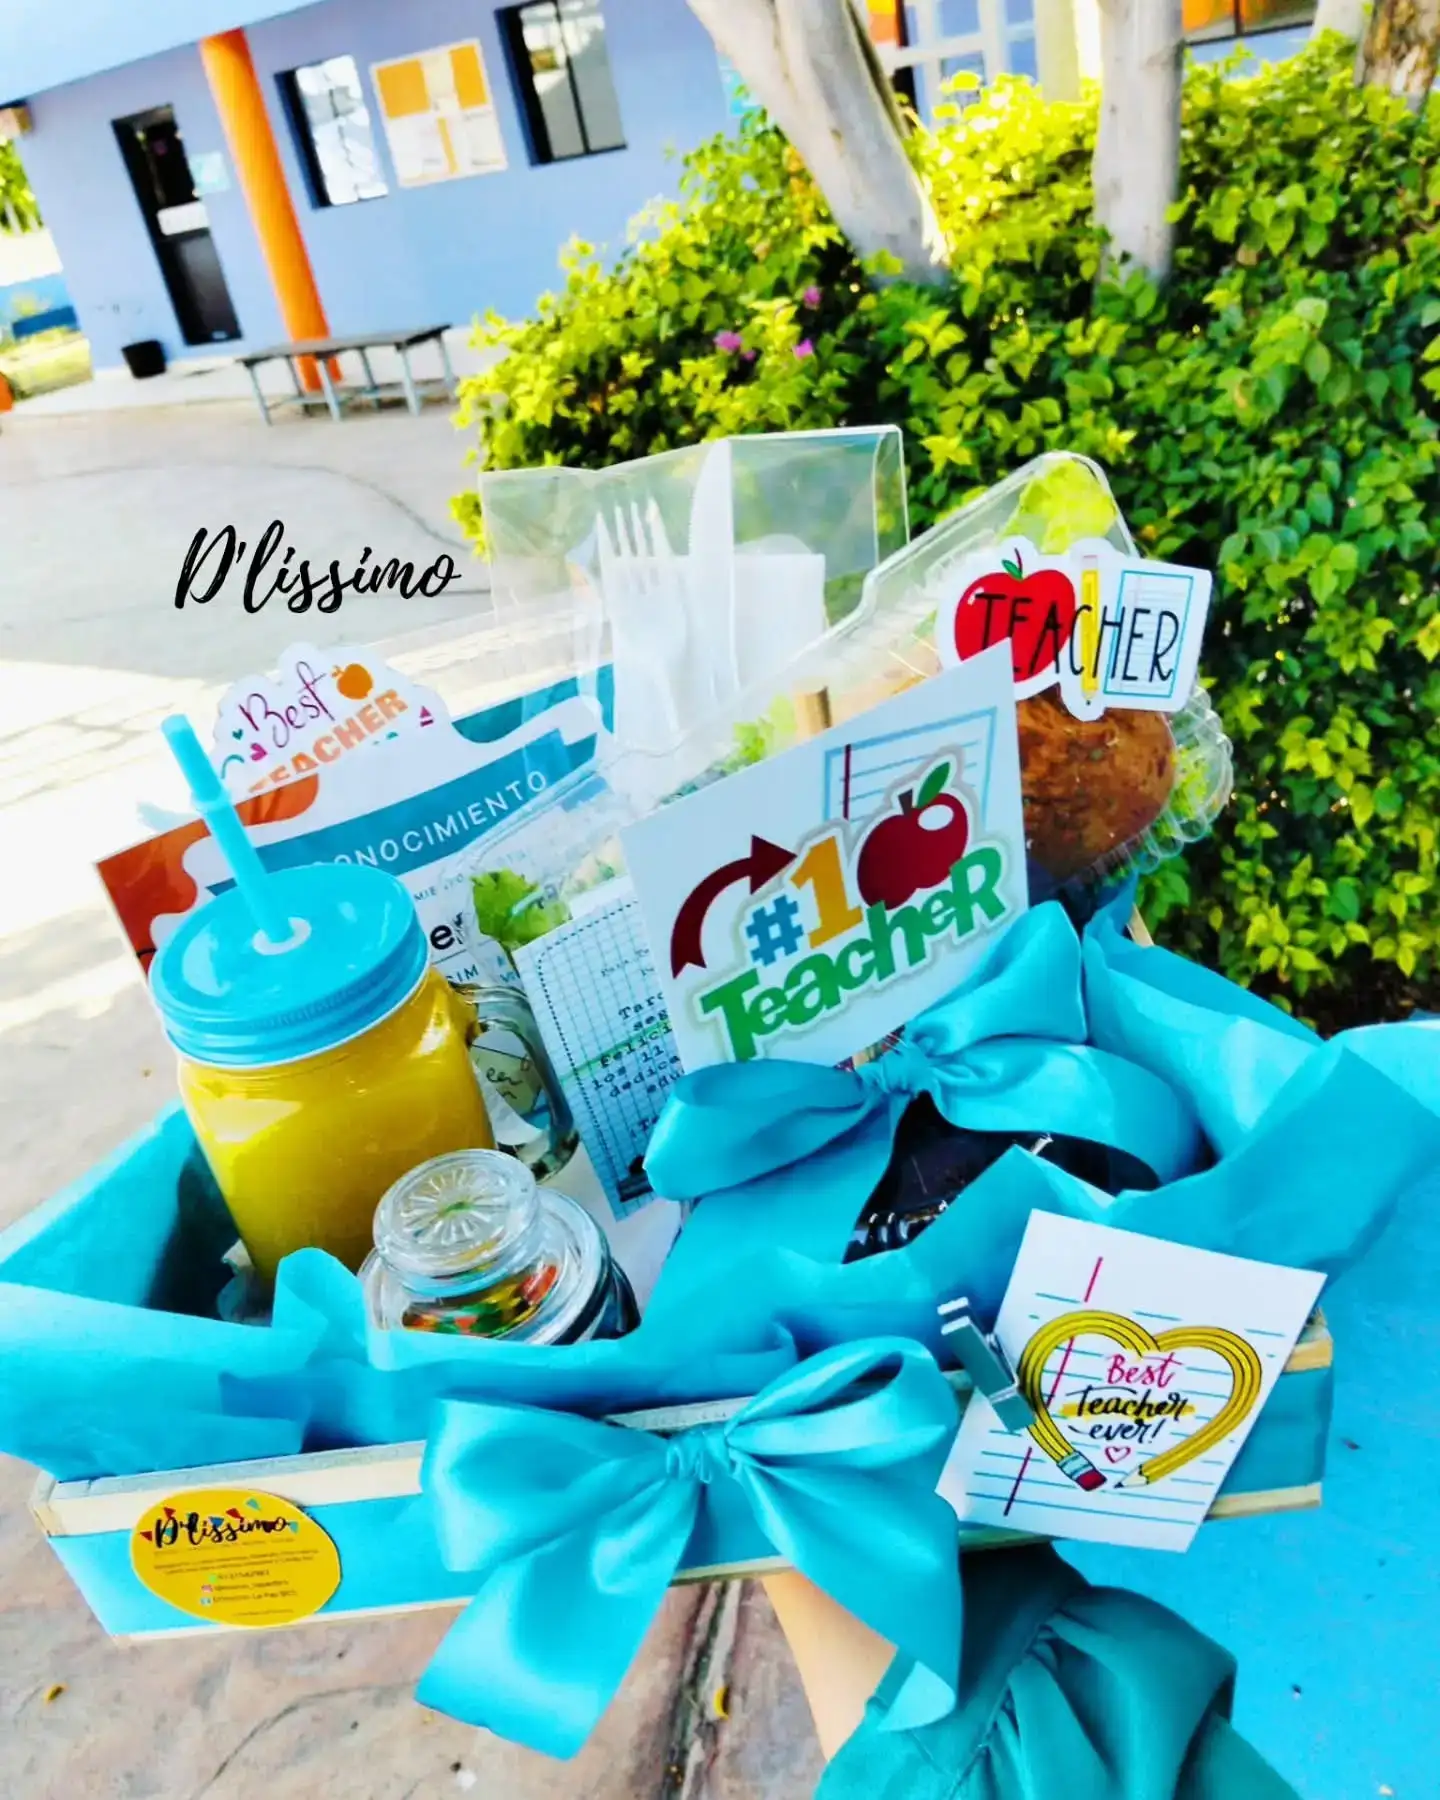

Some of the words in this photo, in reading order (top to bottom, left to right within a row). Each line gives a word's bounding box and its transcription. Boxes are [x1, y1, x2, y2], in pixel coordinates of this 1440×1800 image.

[238, 661, 335, 748] Best
[746, 835, 863, 968] #1
[1107, 1351, 1183, 1389] Best
[1066, 1385, 1189, 1421] Teacher
[1068, 1418, 1167, 1444] ever!
